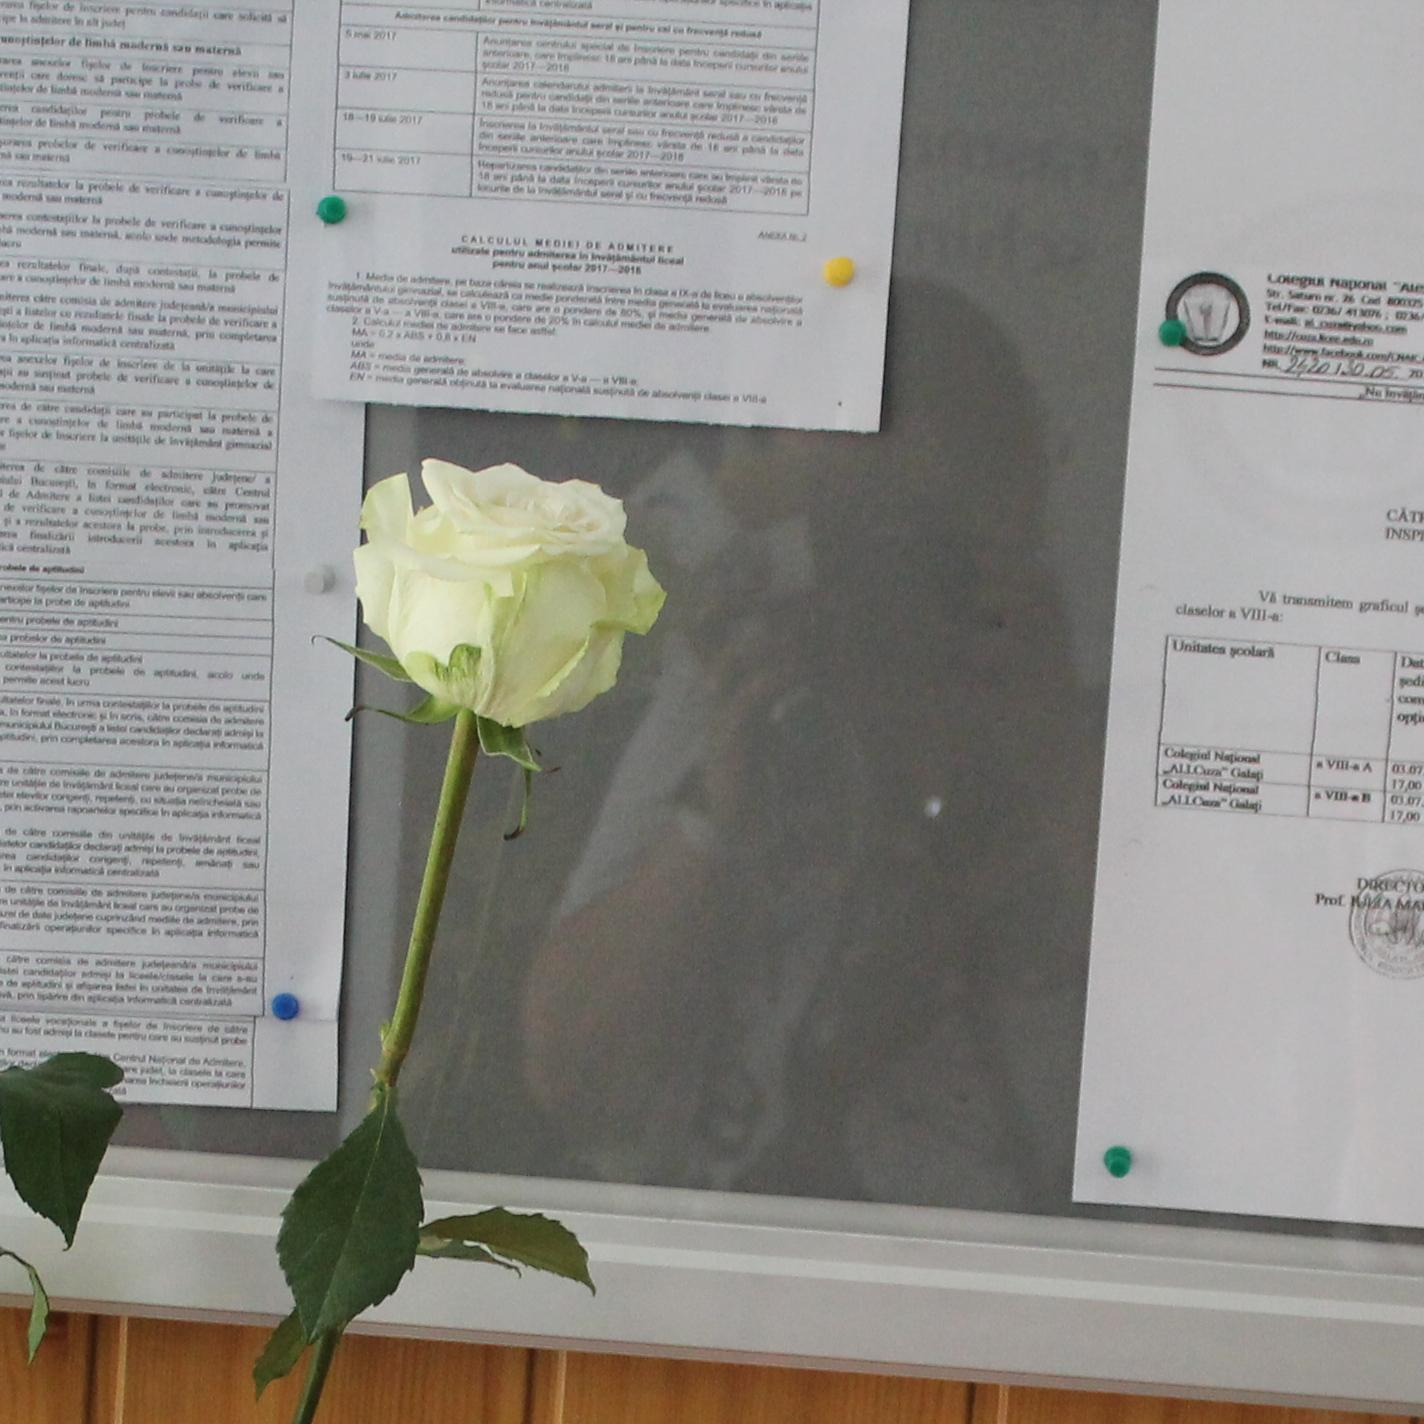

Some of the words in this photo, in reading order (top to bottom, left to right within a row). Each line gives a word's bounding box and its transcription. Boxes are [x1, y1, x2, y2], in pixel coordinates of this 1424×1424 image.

[1175, 604, 1225, 619] claselor
[1282, 593, 1354, 609] transmitem
[1359, 599, 1409, 615] graficul
